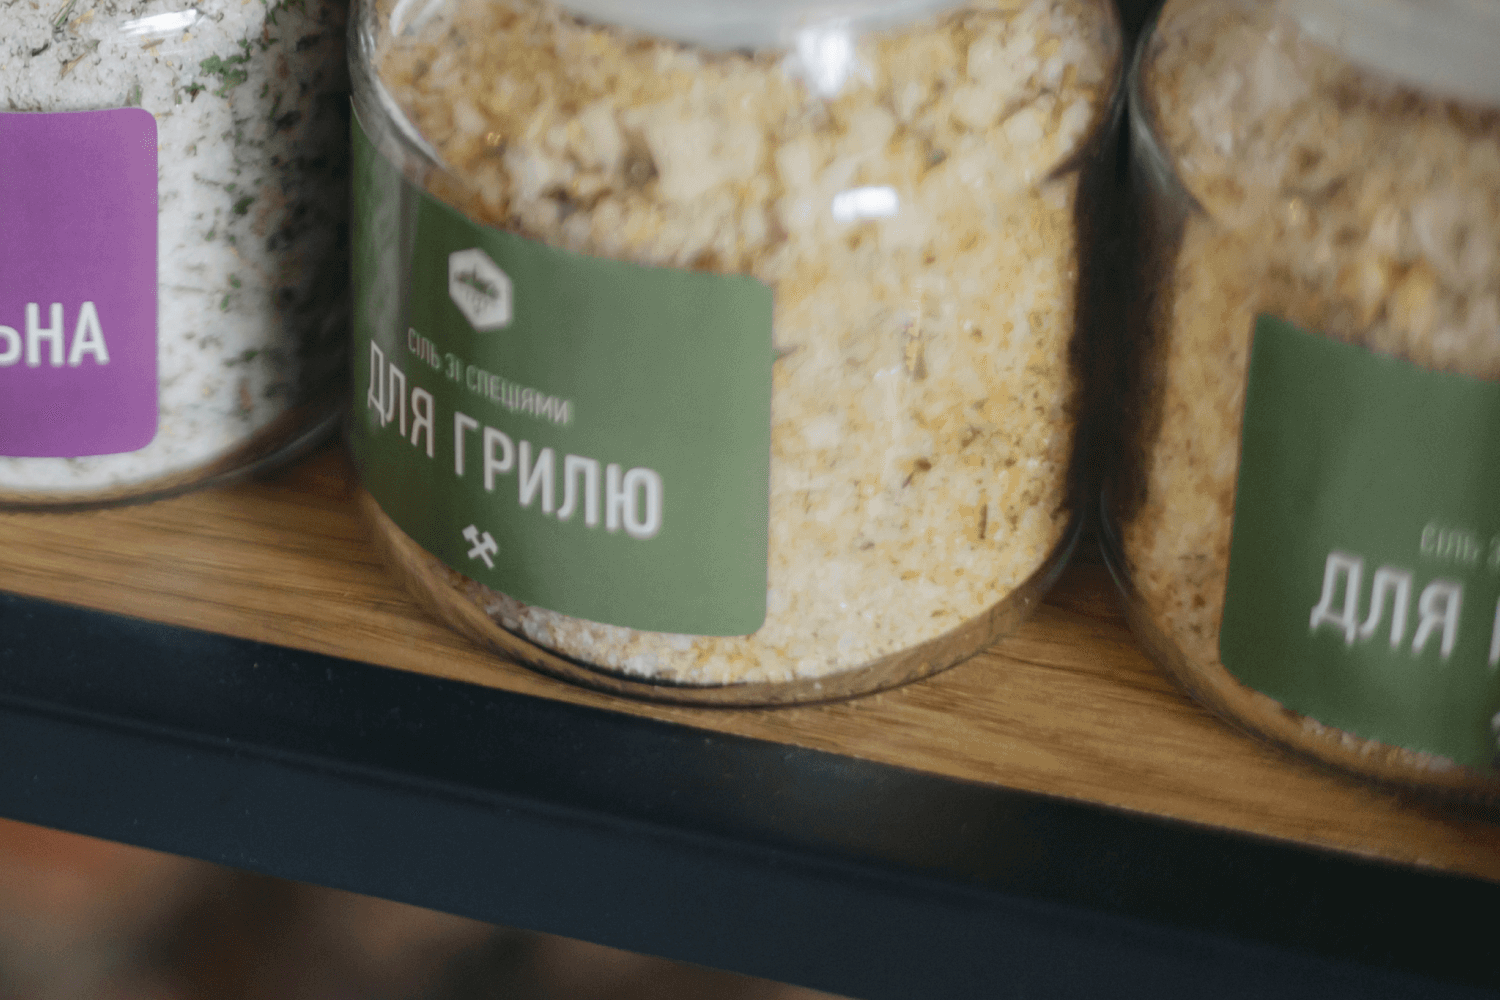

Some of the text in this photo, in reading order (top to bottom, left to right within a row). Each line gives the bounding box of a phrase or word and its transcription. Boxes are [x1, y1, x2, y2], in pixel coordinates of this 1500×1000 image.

[408, 327, 571, 425] СІЛЬ ЗІ СПЕЦІЯМИ
[368, 339, 662, 539] ДЛЯ ГРИЛЮ
[1309, 550, 1462, 658] ДЛЯ
